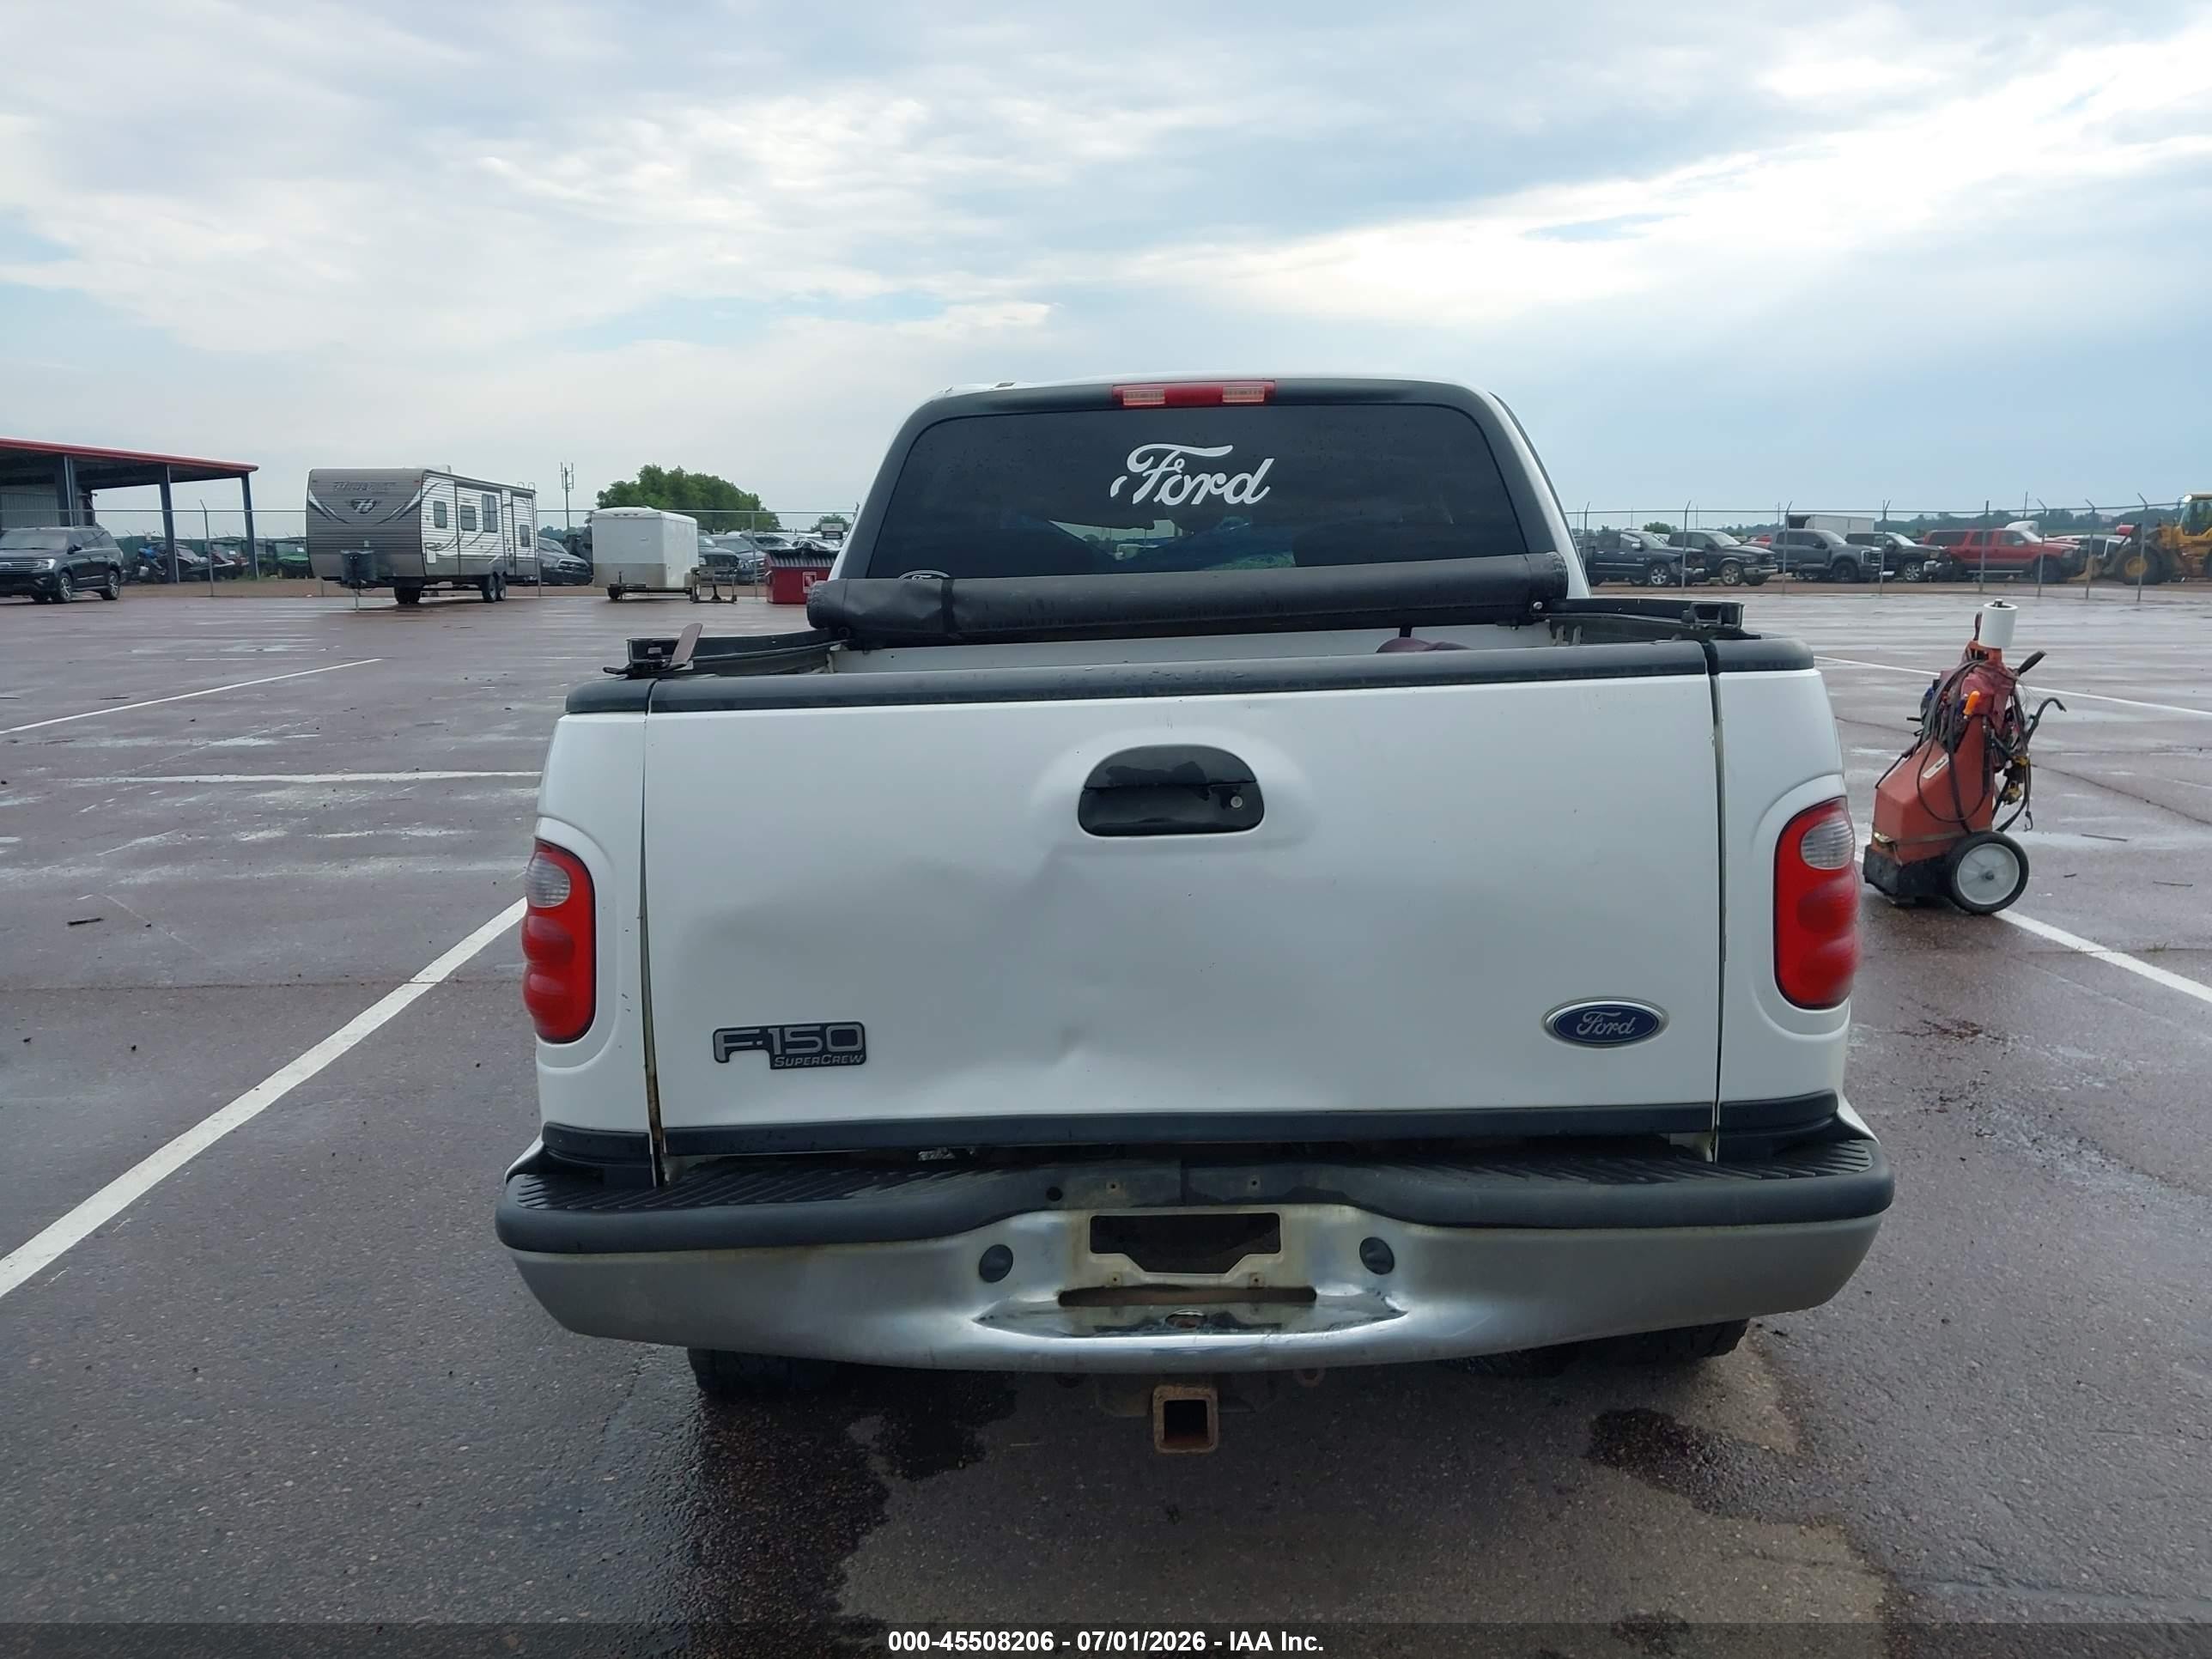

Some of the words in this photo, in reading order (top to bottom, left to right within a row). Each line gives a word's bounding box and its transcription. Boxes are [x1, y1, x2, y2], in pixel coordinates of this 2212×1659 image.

[1109, 443, 1274, 506] Ford
[714, 1024, 864, 1062] F-150
[1577, 1012, 1636, 1036] Ford
